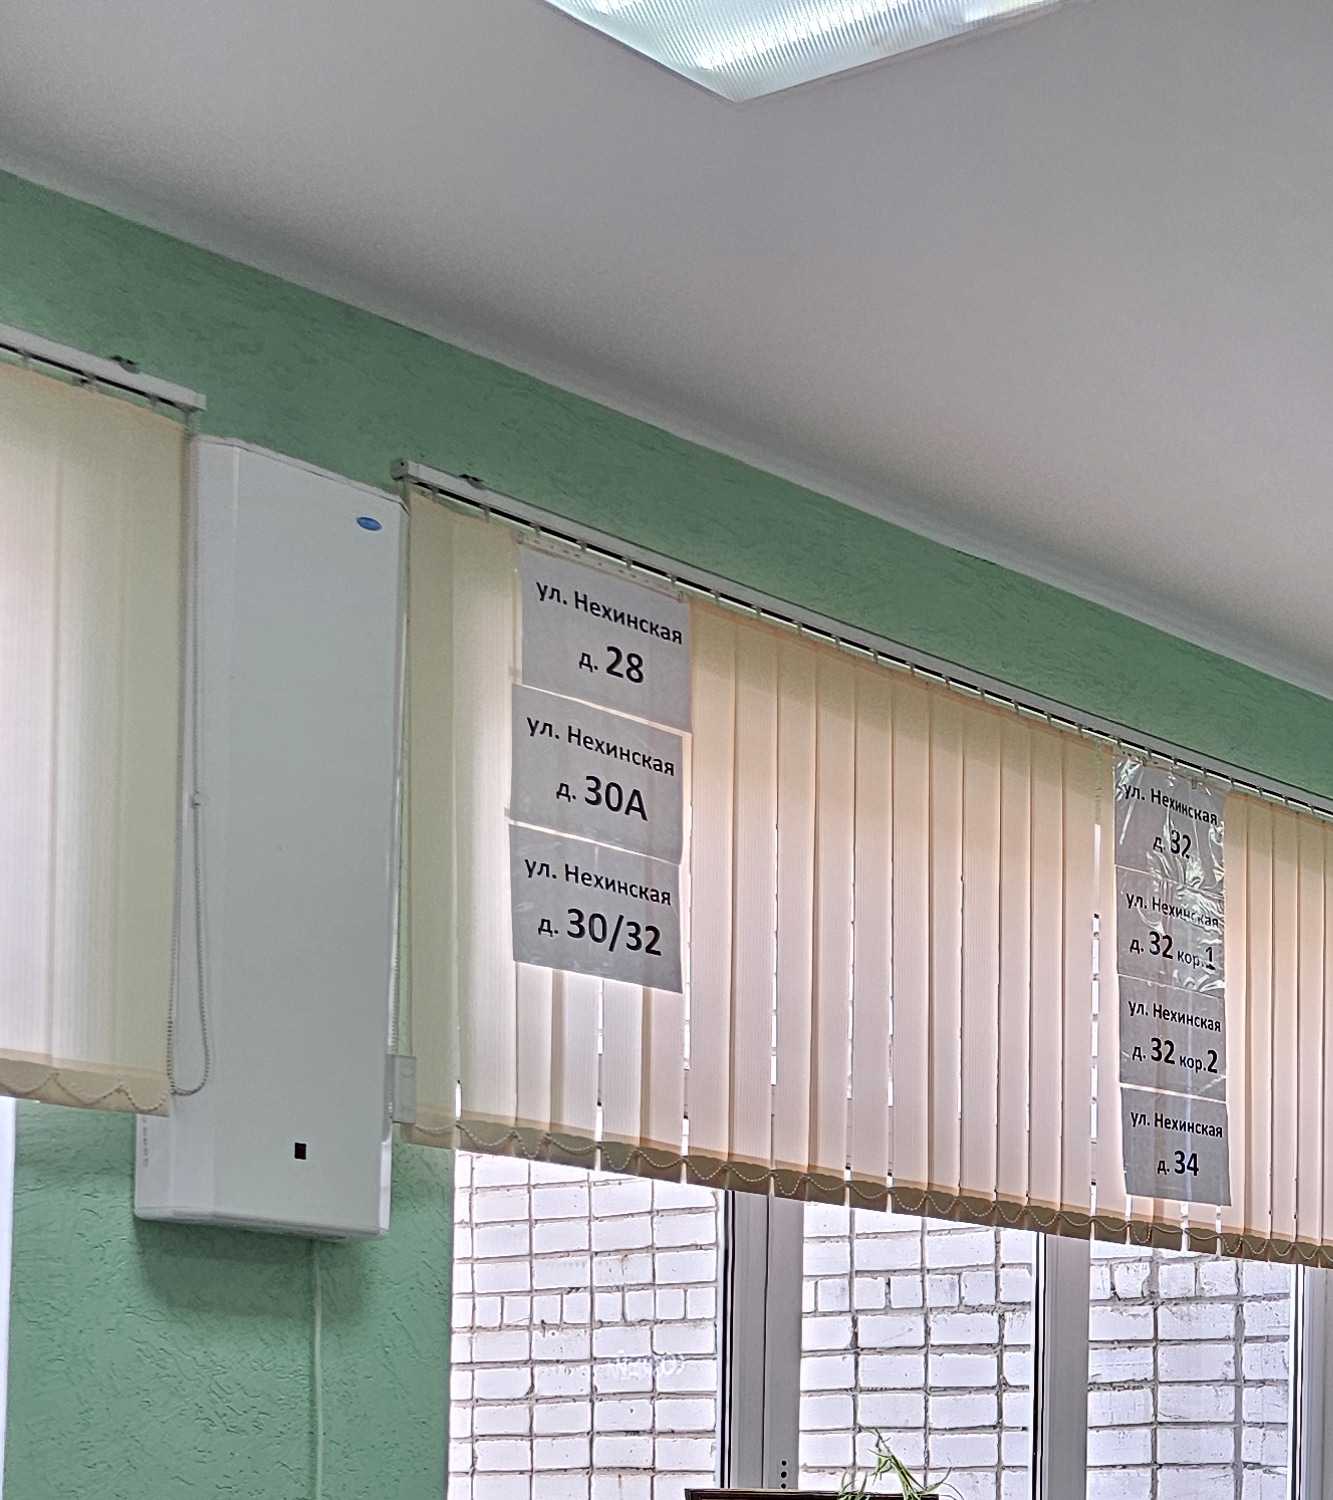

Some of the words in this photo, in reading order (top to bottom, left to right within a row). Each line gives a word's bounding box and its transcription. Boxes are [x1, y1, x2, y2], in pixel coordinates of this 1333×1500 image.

[536, 581, 568, 606] ул.
[574, 590, 683, 646] Нехинская
[579, 651, 599, 671] д.
[605, 645, 645, 684] 28
[526, 716, 560, 740] ул.
[567, 725, 676, 777] Нехинская
[556, 780, 577, 802] д.
[584, 775, 648, 821] 30А
[1124, 783, 1145, 801] ул.
[1151, 788, 1219, 825] Нехинская
[1153, 836, 1166, 852] д.
[1170, 829, 1192, 859] 32
[524, 857, 557, 880] ул.
[564, 864, 672, 906] Нехинская
[1126, 893, 1147, 909] ул.
[1152, 896, 1219, 927] Нехинская
[537, 916, 559, 938] д.
[566, 908, 662, 957] 30/32
[1129, 938, 1144, 954] д.
[1149, 931, 1174, 960] 32
[1128, 1000, 1149, 1016] ул.
[1153, 1003, 1221, 1032] Нехинская
[1132, 1046, 1147, 1061] д.
[1150, 1037, 1175, 1065] 32
[1130, 1112, 1150, 1127] ул.
[1154, 1112, 1223, 1138] Нехинская
[1157, 1159, 1171, 1175] д.
[1174, 1150, 1200, 1176] 34
